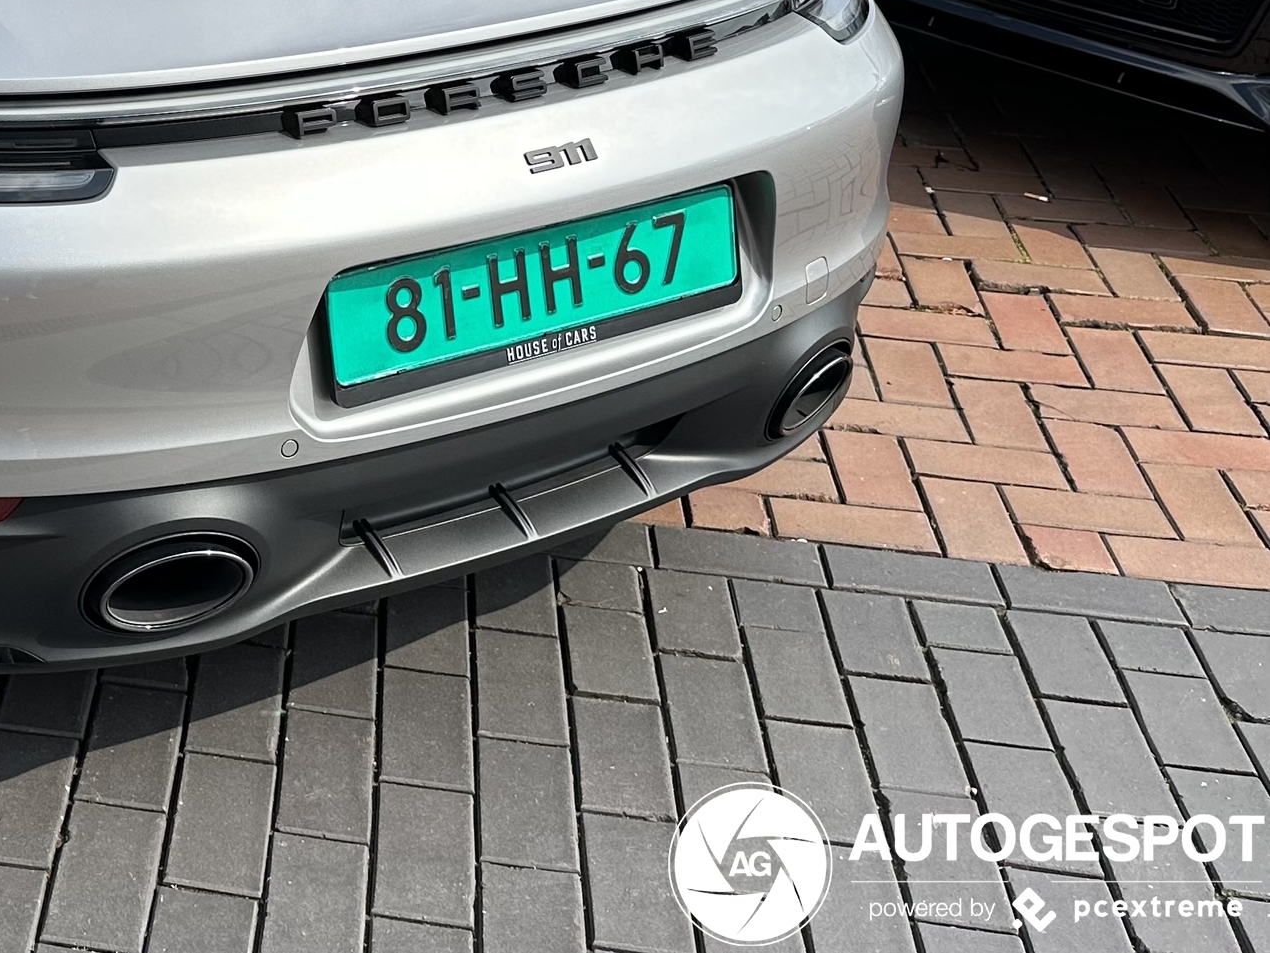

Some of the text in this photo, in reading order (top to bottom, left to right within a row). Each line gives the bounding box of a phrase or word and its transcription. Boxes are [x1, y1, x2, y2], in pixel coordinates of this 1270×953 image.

[283, 28, 718, 139] PORSCHE
[523, 137, 598, 174] 911
[385, 211, 687, 354] 81-HH-67
[506, 325, 597, 362] HOUSE of CARS
